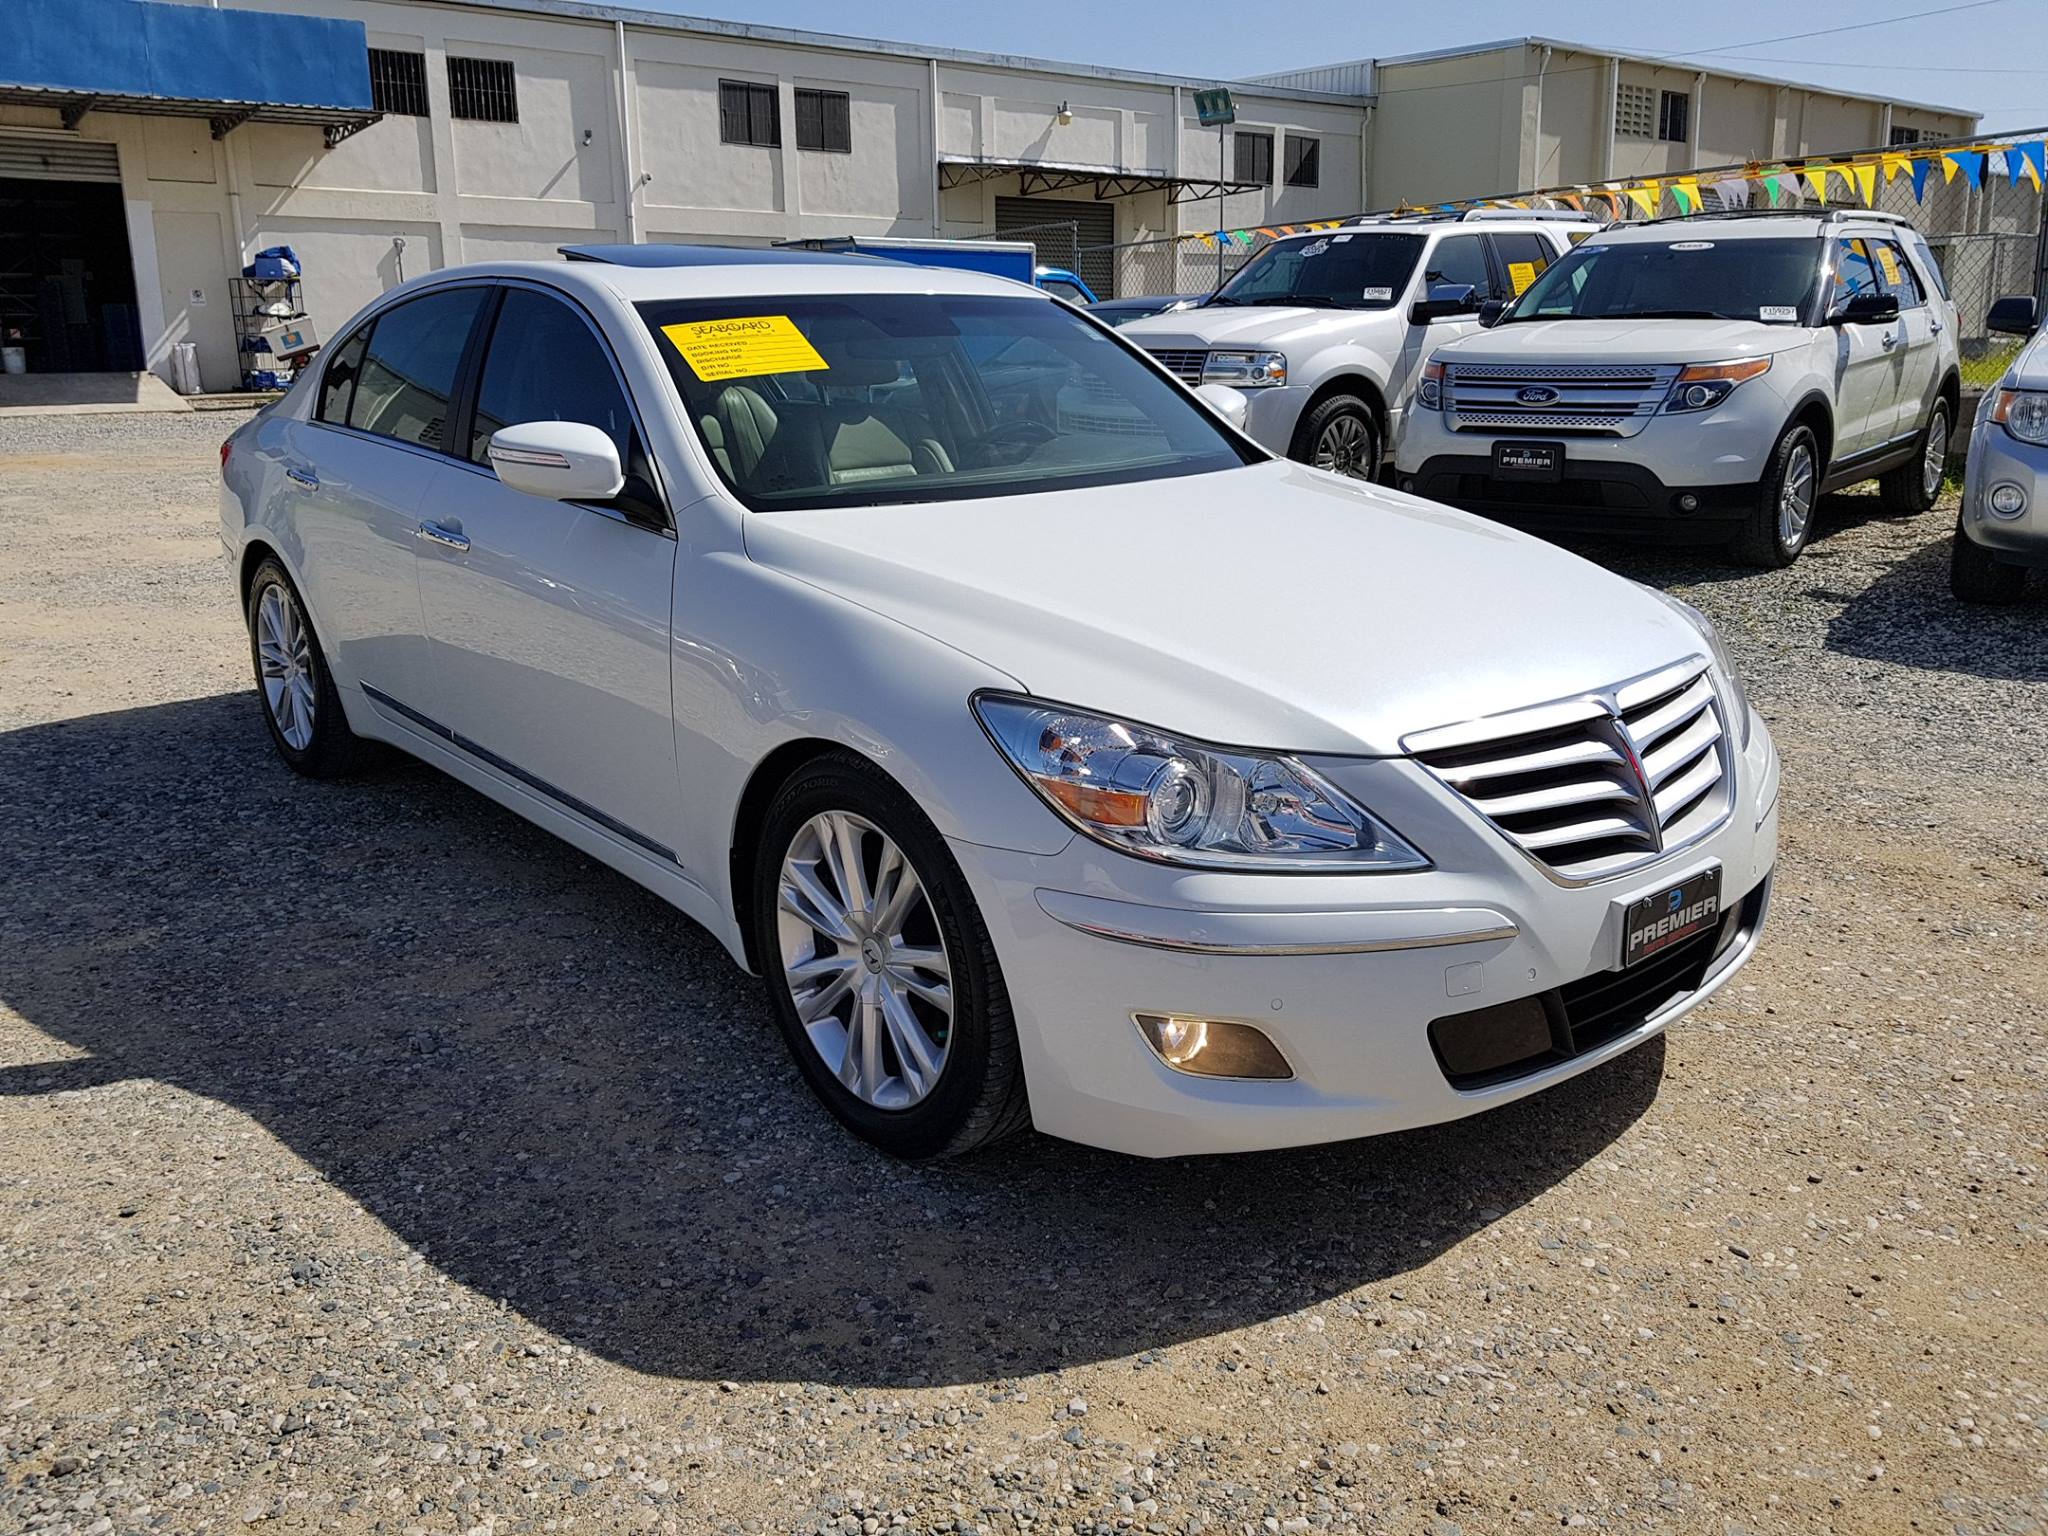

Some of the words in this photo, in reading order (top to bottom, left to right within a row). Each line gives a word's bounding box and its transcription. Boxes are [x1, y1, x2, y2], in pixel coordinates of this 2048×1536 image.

[690, 321, 771, 335] SEABOARD
[691, 349, 729, 357] BOOKING
[1522, 389, 1550, 401] Ford
[1502, 456, 1551, 466] PREMIER
[1629, 895, 1718, 952] PREMIER
